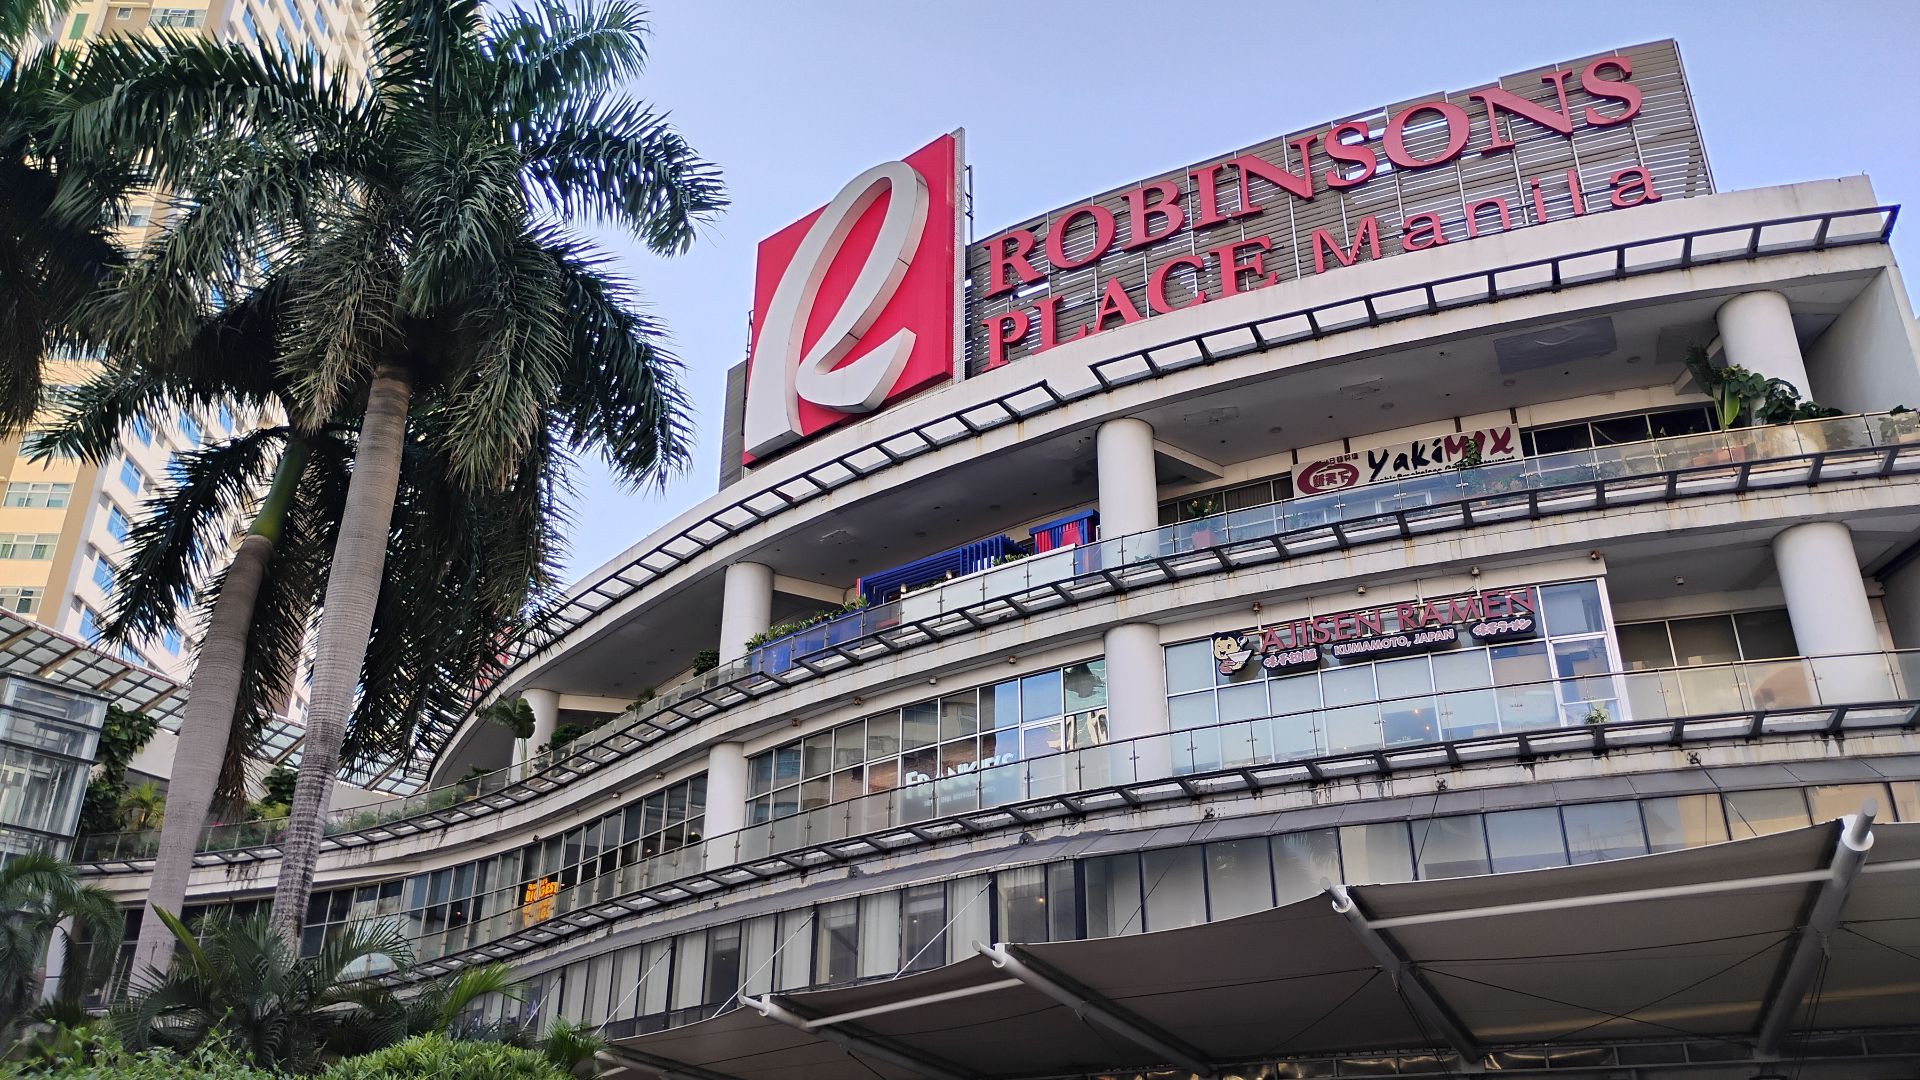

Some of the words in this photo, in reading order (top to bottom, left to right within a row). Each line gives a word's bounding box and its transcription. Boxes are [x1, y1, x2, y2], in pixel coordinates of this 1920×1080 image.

[981, 55, 1643, 299] ROBINSONS
[980, 236, 1278, 374] PLACE
[1312, 165, 1662, 274] Manila
[1260, 609, 1383, 654] AJISEN
[1396, 586, 1535, 631] RAMEN
[1333, 635, 1412, 656] KUMAMOTO,
[1413, 628, 1455, 645] JAPAN
